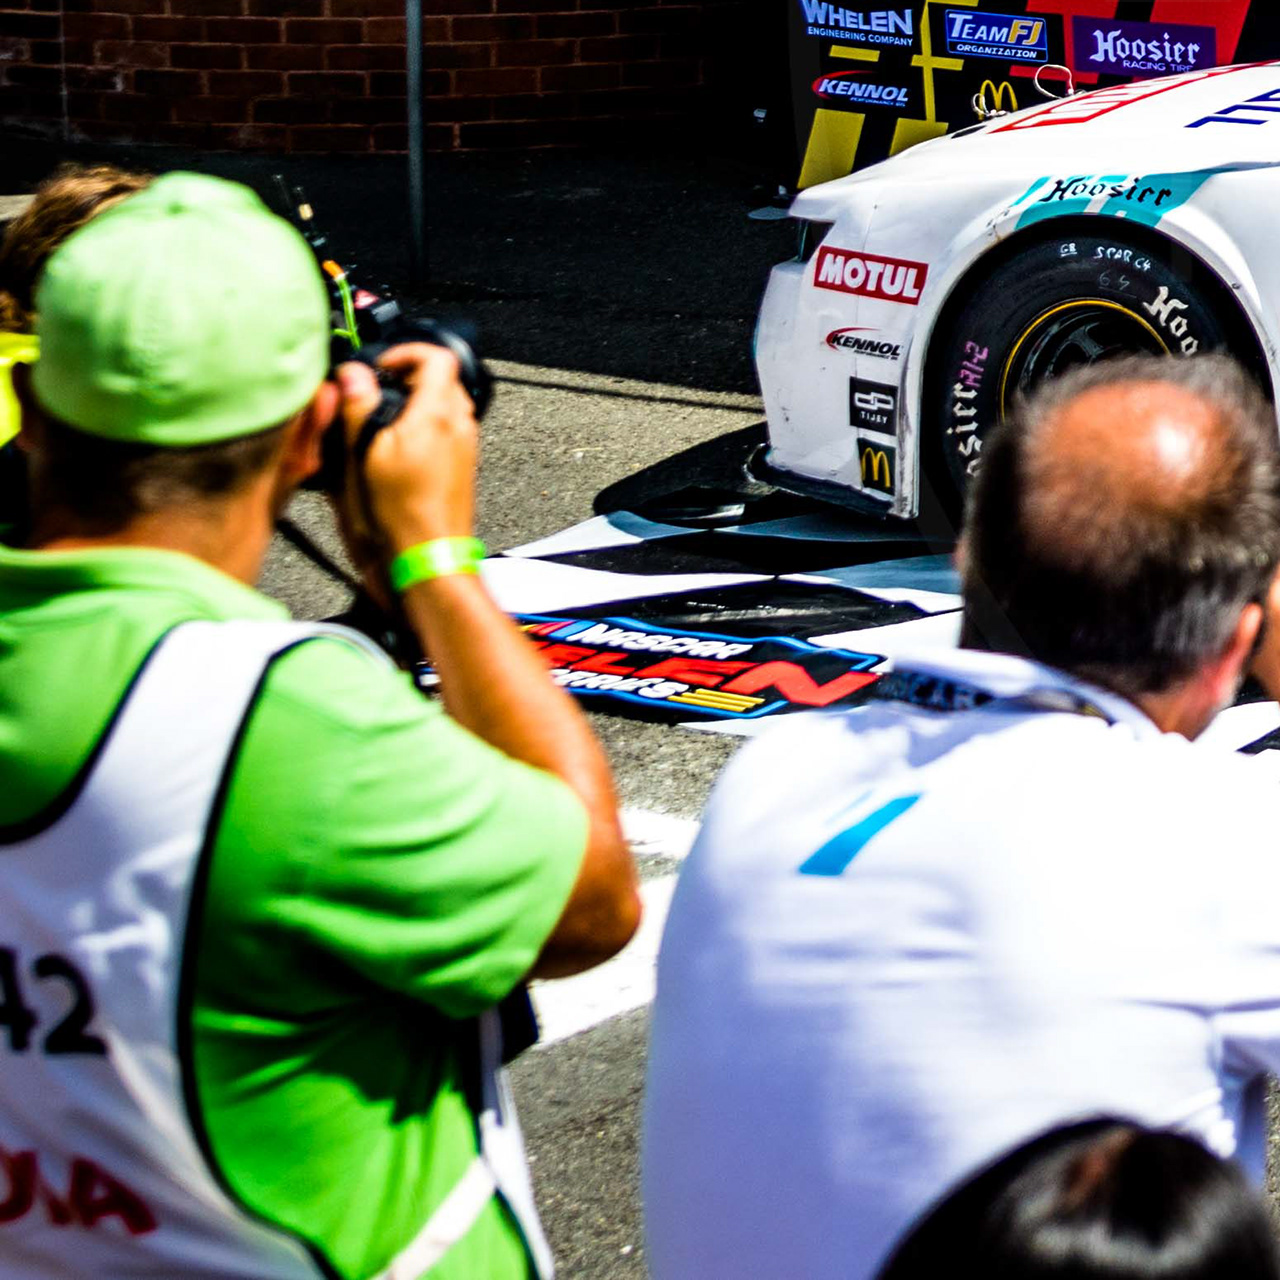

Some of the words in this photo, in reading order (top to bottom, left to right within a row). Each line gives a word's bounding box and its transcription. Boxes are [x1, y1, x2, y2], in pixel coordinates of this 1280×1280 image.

[808, 26, 866, 44] ENGINEERING
[867, 32, 913, 47] COMPANY
[1089, 30, 1201, 64] Hoosier
[956, 44, 1037, 58] ORGANIZATION
[1123, 59, 1166, 72] RACING
[819, 79, 909, 102] KENNOL
[1041, 177, 1172, 207] Hoosier
[818, 256, 921, 299] MOTUL
[831, 331, 901, 357] KENNOL
[861, 410, 888, 424] TIJEY
[567, 623, 754, 661] NASCAR
[532, 640, 880, 708] ELEN
